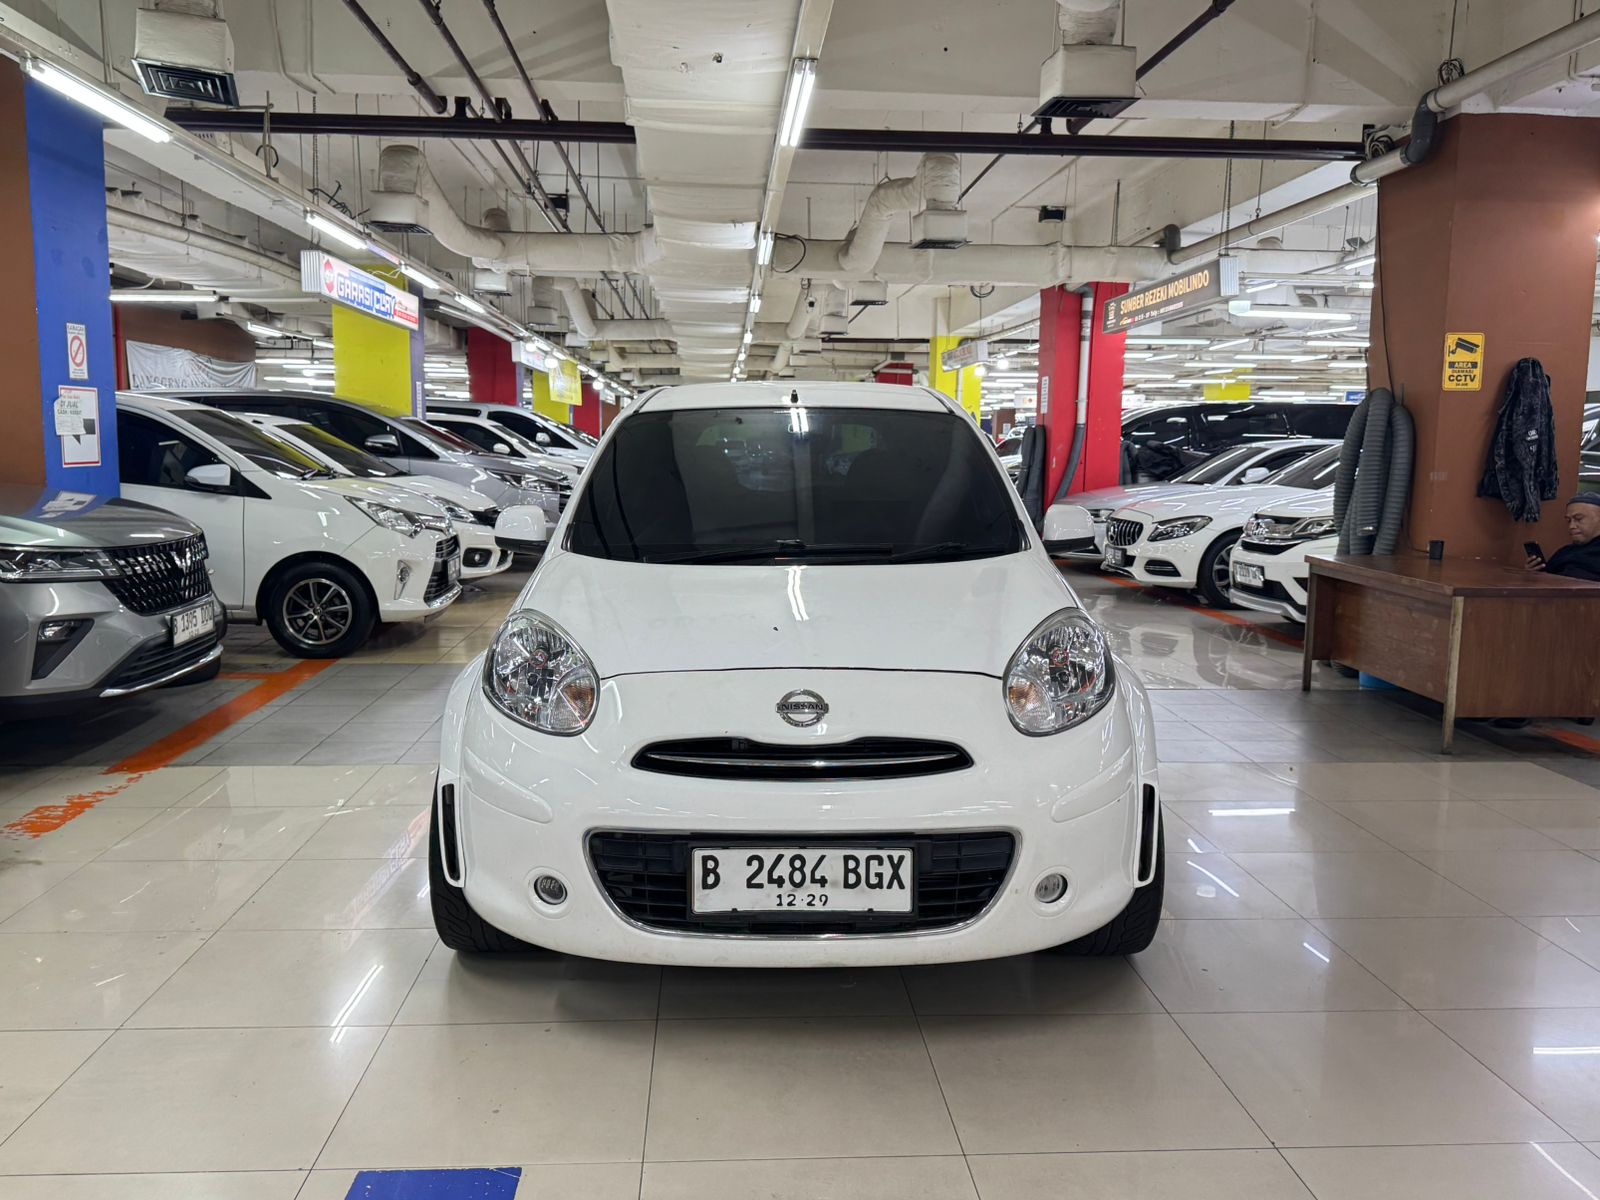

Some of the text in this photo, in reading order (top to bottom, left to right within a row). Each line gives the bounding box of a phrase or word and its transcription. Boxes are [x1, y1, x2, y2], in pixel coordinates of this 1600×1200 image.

[337, 274, 374, 310] GARASI
[1120, 293, 1144, 314] SUMBER
[1144, 284, 1168, 305] REZEKI
[1168, 270, 1209, 298] MOBILINDO
[1448, 374, 1476, 382] CCTV
[701, 854, 905, 890] B 2484 BGX
